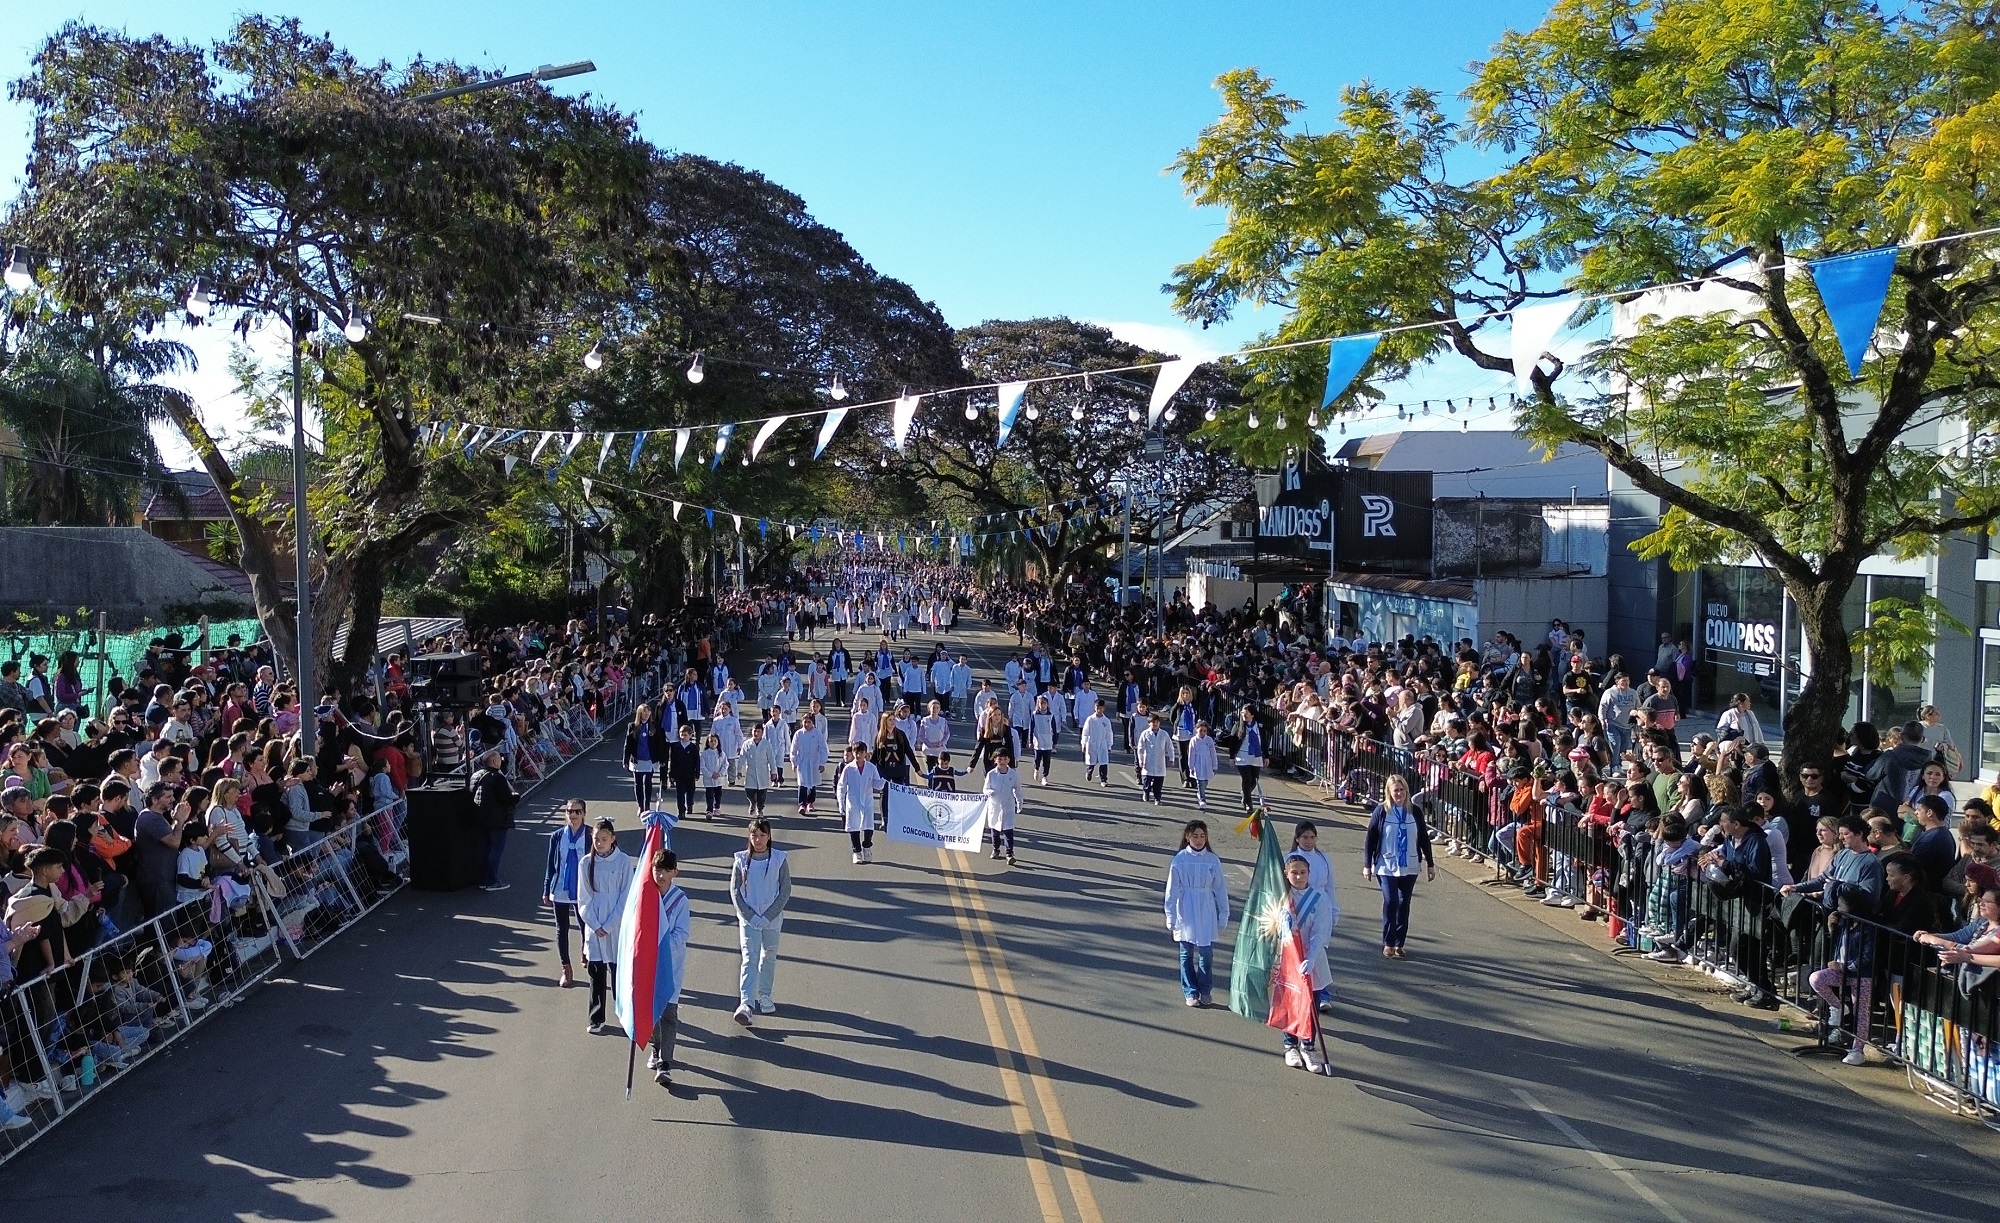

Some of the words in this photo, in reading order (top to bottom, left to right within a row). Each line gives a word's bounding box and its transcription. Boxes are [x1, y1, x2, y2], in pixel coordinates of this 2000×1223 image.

[1708, 603, 1728, 617] NUEVO
[1705, 619, 1775, 654] COMPASS
[1737, 661, 1753, 674] SERIE
[935, 792, 960, 801] FAUSTINO
[902, 825, 935, 840] CONCORDIA
[937, 834, 956, 844] ENTRE
